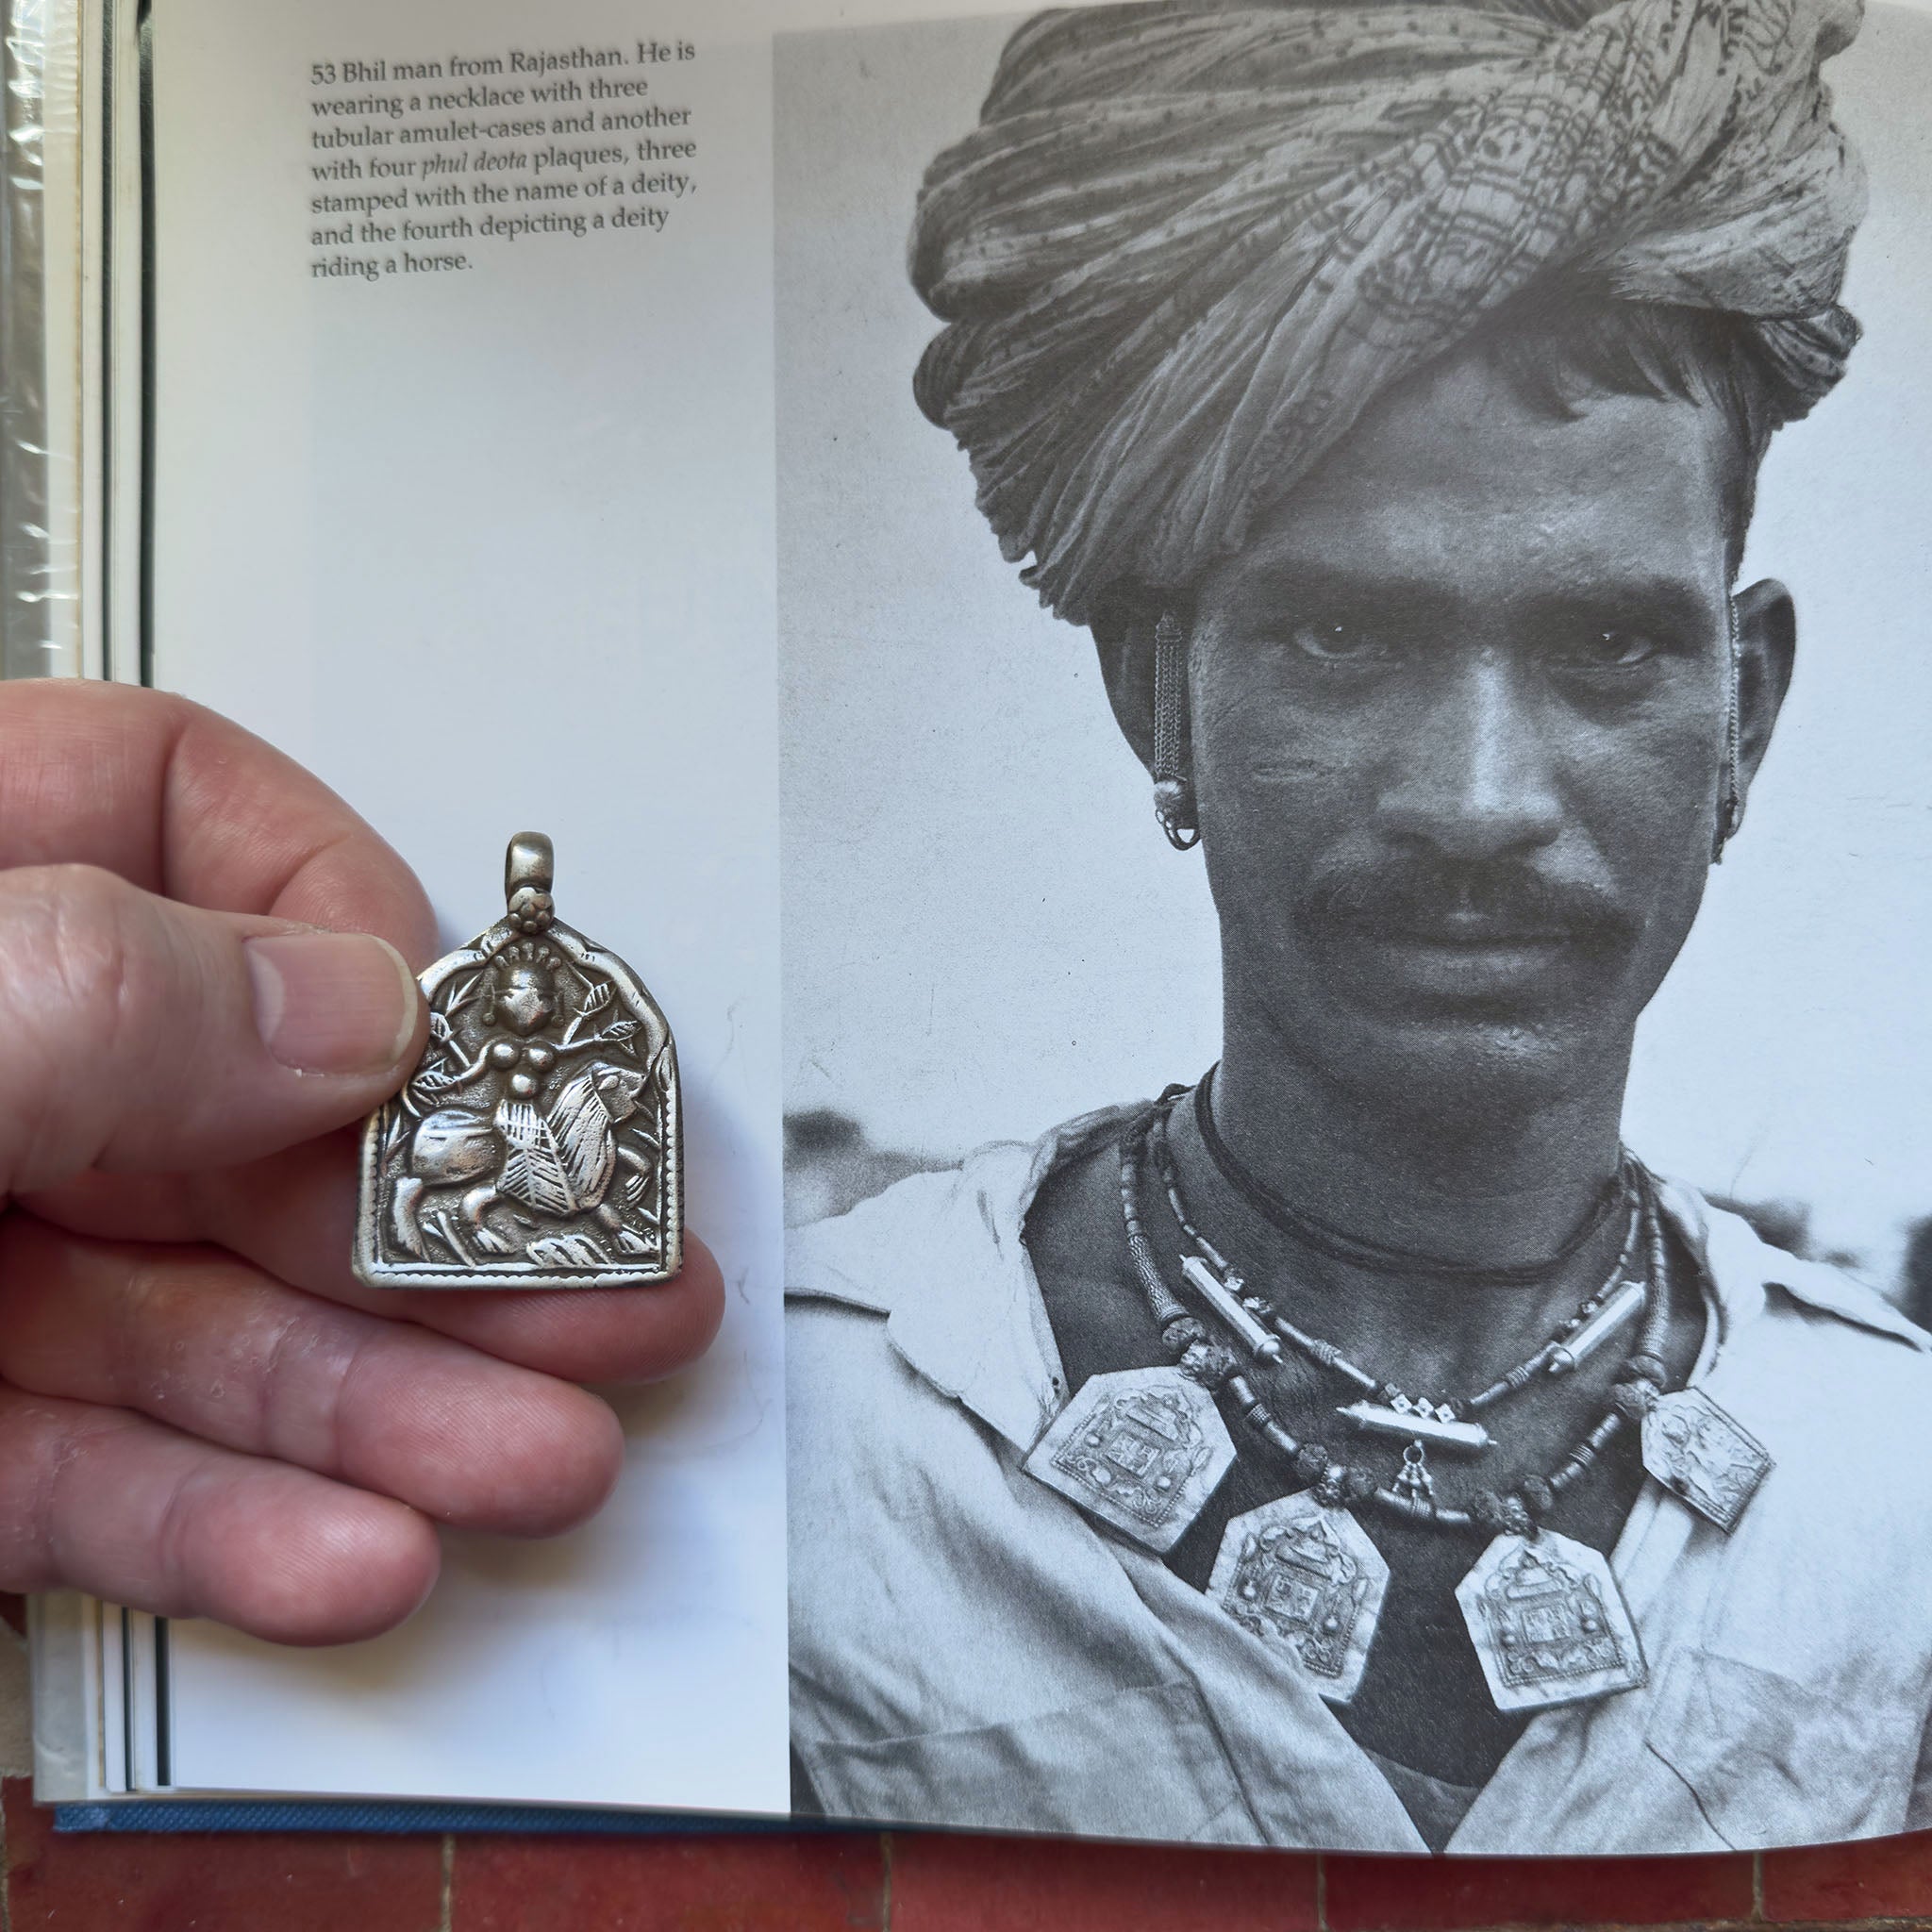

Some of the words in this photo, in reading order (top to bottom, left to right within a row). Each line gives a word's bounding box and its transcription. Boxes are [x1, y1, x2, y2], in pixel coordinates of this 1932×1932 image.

[311, 63, 337, 85] 53
[342, 60, 386, 83] Bhil
[392, 62, 442, 80] man
[450, 56, 503, 76] from
[509, 46, 628, 76] Rajasthan.
[637, 42, 671, 64] He
[677, 41, 695, 60] is
[311, 94, 404, 119] wearing
[409, 96, 421, 111] a
[427, 85, 525, 109] necklace
[530, 79, 582, 103] with
[589, 77, 648, 99] three
[311, 125, 394, 149] tubular
[400, 120, 546, 143] amulet-cases
[552, 110, 594, 134] and
[601, 105, 691, 131] another
[311, 158, 362, 181] with
[369, 158, 416, 177] four
[422, 151, 468, 181] phul
[474, 150, 527, 172] deota
[533, 146, 629, 175] plaques,
[637, 139, 696, 160] three
[311, 187, 408, 218] stamped
[414, 184, 466, 207] with
[473, 182, 509, 204] the
[515, 182, 578, 201] name
[584, 175, 608, 197] of
[612, 179, 625, 195] a
[631, 172, 696, 198] deity,
[310, 223, 354, 245] and
[360, 221, 396, 242] the
[402, 215, 473, 241] fourth
[479, 212, 587, 242] depicting
[592, 213, 605, 229] a
[611, 206, 669, 233] deity
[310, 256, 379, 282] riding
[385, 258, 397, 274] a
[403, 251, 473, 273] horse.
